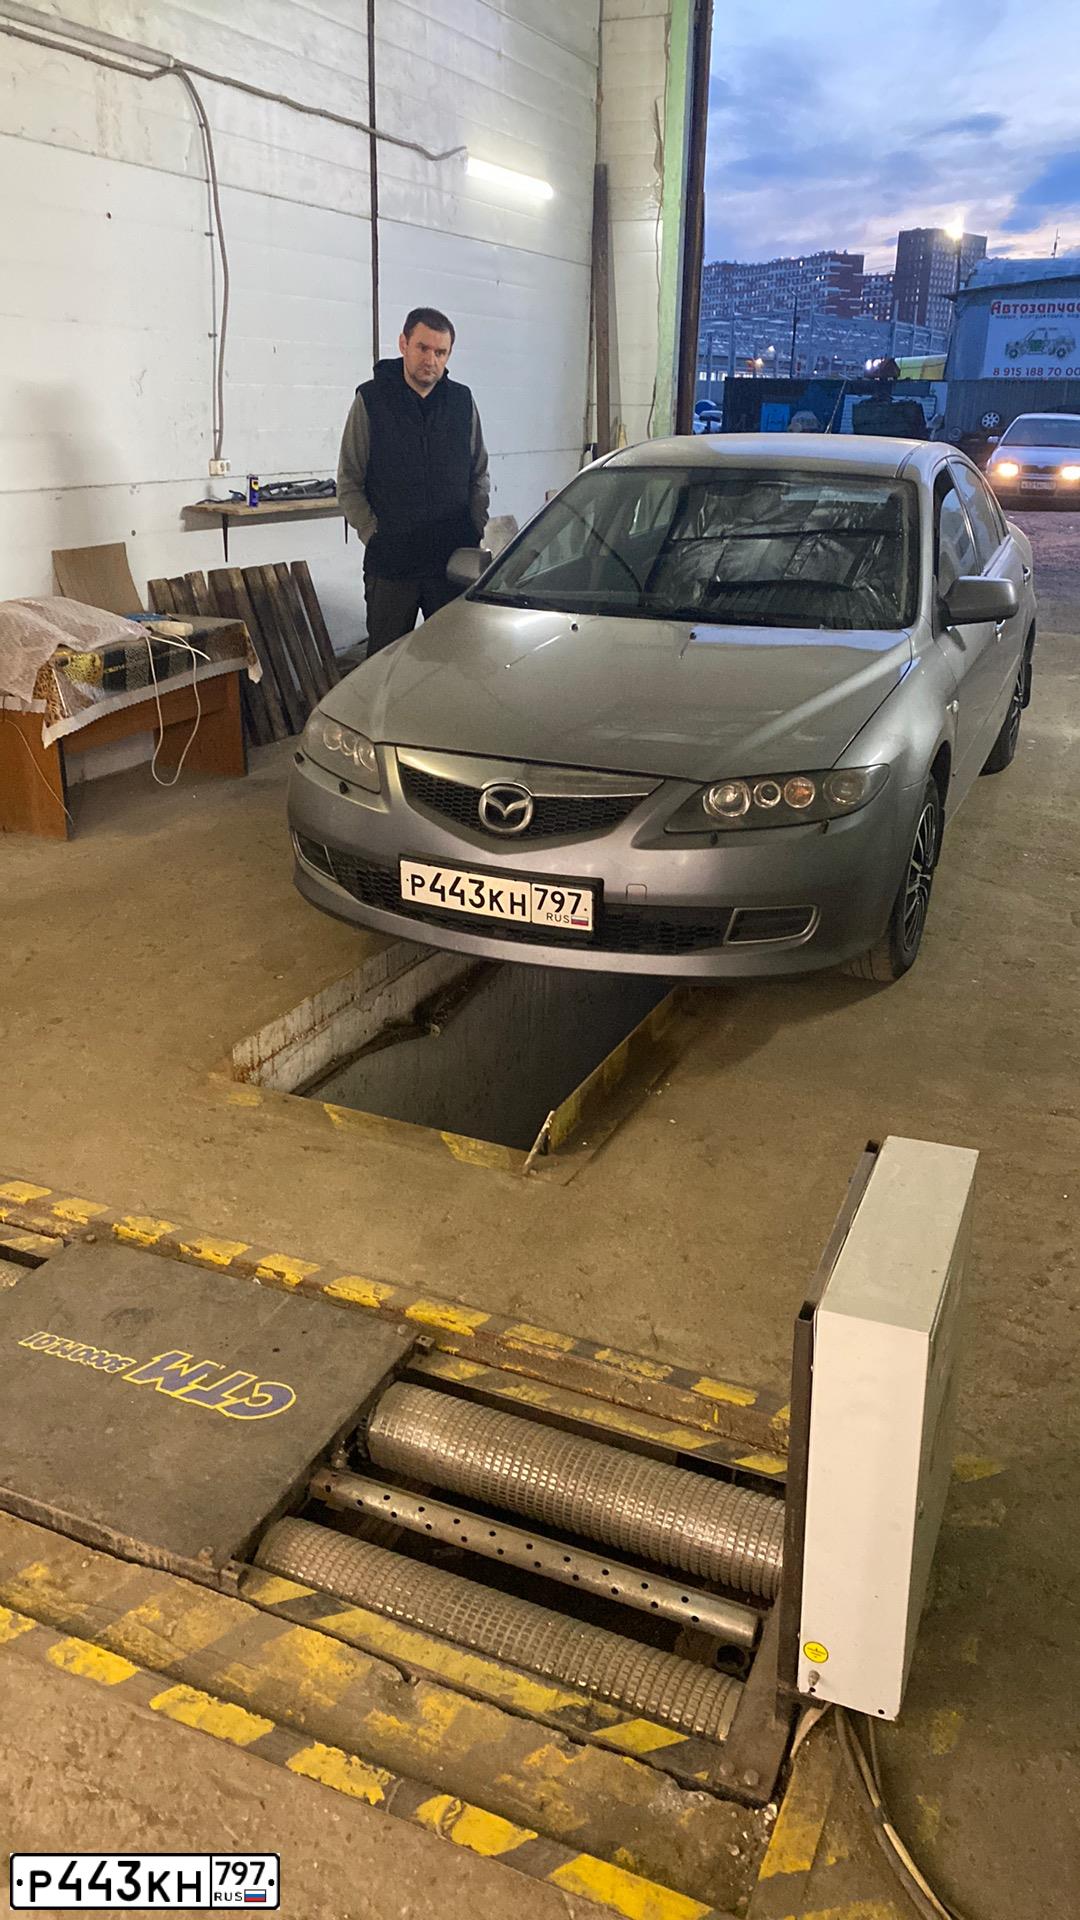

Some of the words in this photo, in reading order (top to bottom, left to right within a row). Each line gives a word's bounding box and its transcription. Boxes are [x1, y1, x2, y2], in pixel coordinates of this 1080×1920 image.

[993, 368, 999, 376] 8
[1004, 368, 1021, 376] 915
[1026, 368, 1043, 376] 188
[1047, 368, 1061, 376] 70
[410, 872, 526, 916] Р443КН
[534, 887, 582, 915] 797
[546, 912, 570, 924] RUS
